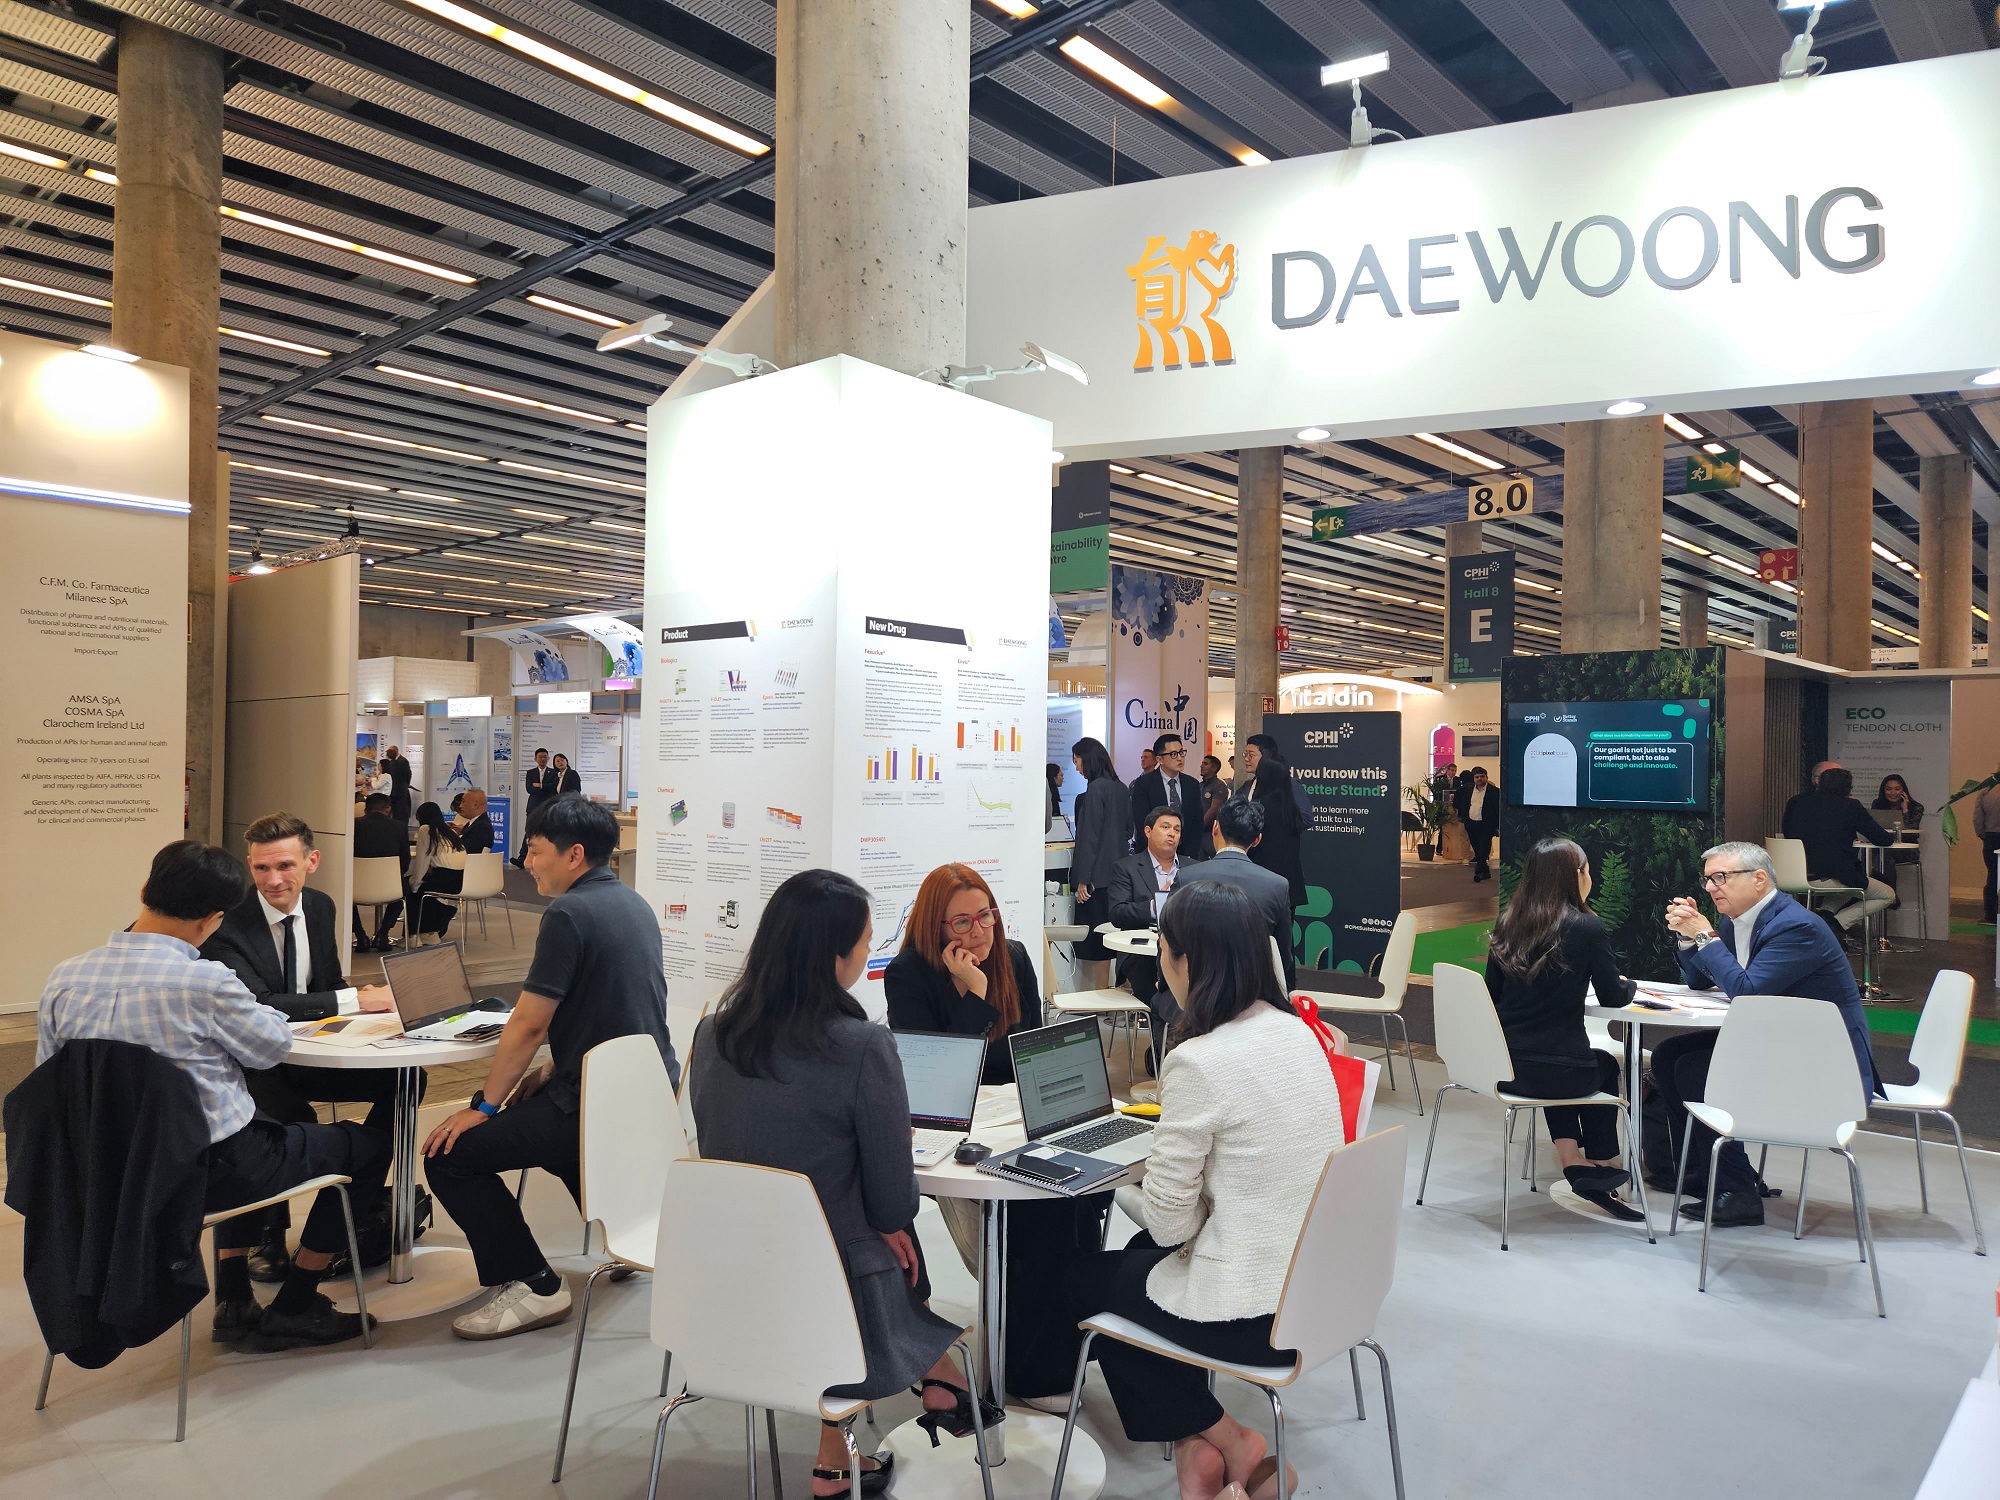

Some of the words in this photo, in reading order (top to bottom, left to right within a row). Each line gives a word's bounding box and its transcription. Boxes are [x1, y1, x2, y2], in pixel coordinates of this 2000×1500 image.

[1272, 186, 1886, 329] DAEWOONG
[1474, 482, 1527, 516] 8.0
[1052, 537, 1102, 552] tainability
[1051, 556, 1067, 564] tre
[1464, 568, 1488, 577] CPHI
[40, 577, 68, 587] C.F.M.
[72, 580, 87, 589] Co.
[91, 582, 150, 595] Farmaceutica
[1464, 588, 1488, 598] Hall
[1492, 586, 1499, 596] 8
[66, 593, 106, 603] Milanese
[110, 596, 128, 606] SpA
[20, 608, 58, 616] Distribution
[869, 620, 886, 632] New
[888, 622, 907, 636] Drug
[1470, 608, 1493, 642] E
[664, 629, 689, 640] Product
[69, 695, 99, 703] AMSA
[102, 696, 121, 706] SpA
[65, 707, 103, 716] COSMA
[106, 709, 124, 718] SpA
[1125, 698, 1173, 730] China
[1846, 708, 1886, 720] ECO
[43, 719, 94, 728] Clarochem
[97, 721, 128, 729] Ireland
[1845, 724, 1896, 732] TENDON
[1900, 723, 1942, 732] CLOTH
[1304, 730, 1339, 744] CPHI
[1297, 769, 1319, 780] you
[1323, 767, 1359, 779] know
[1361, 767, 1387, 780] this
[1341, 784, 1388, 796] Stand?
[1316, 825, 1365, 835] sustainability!
